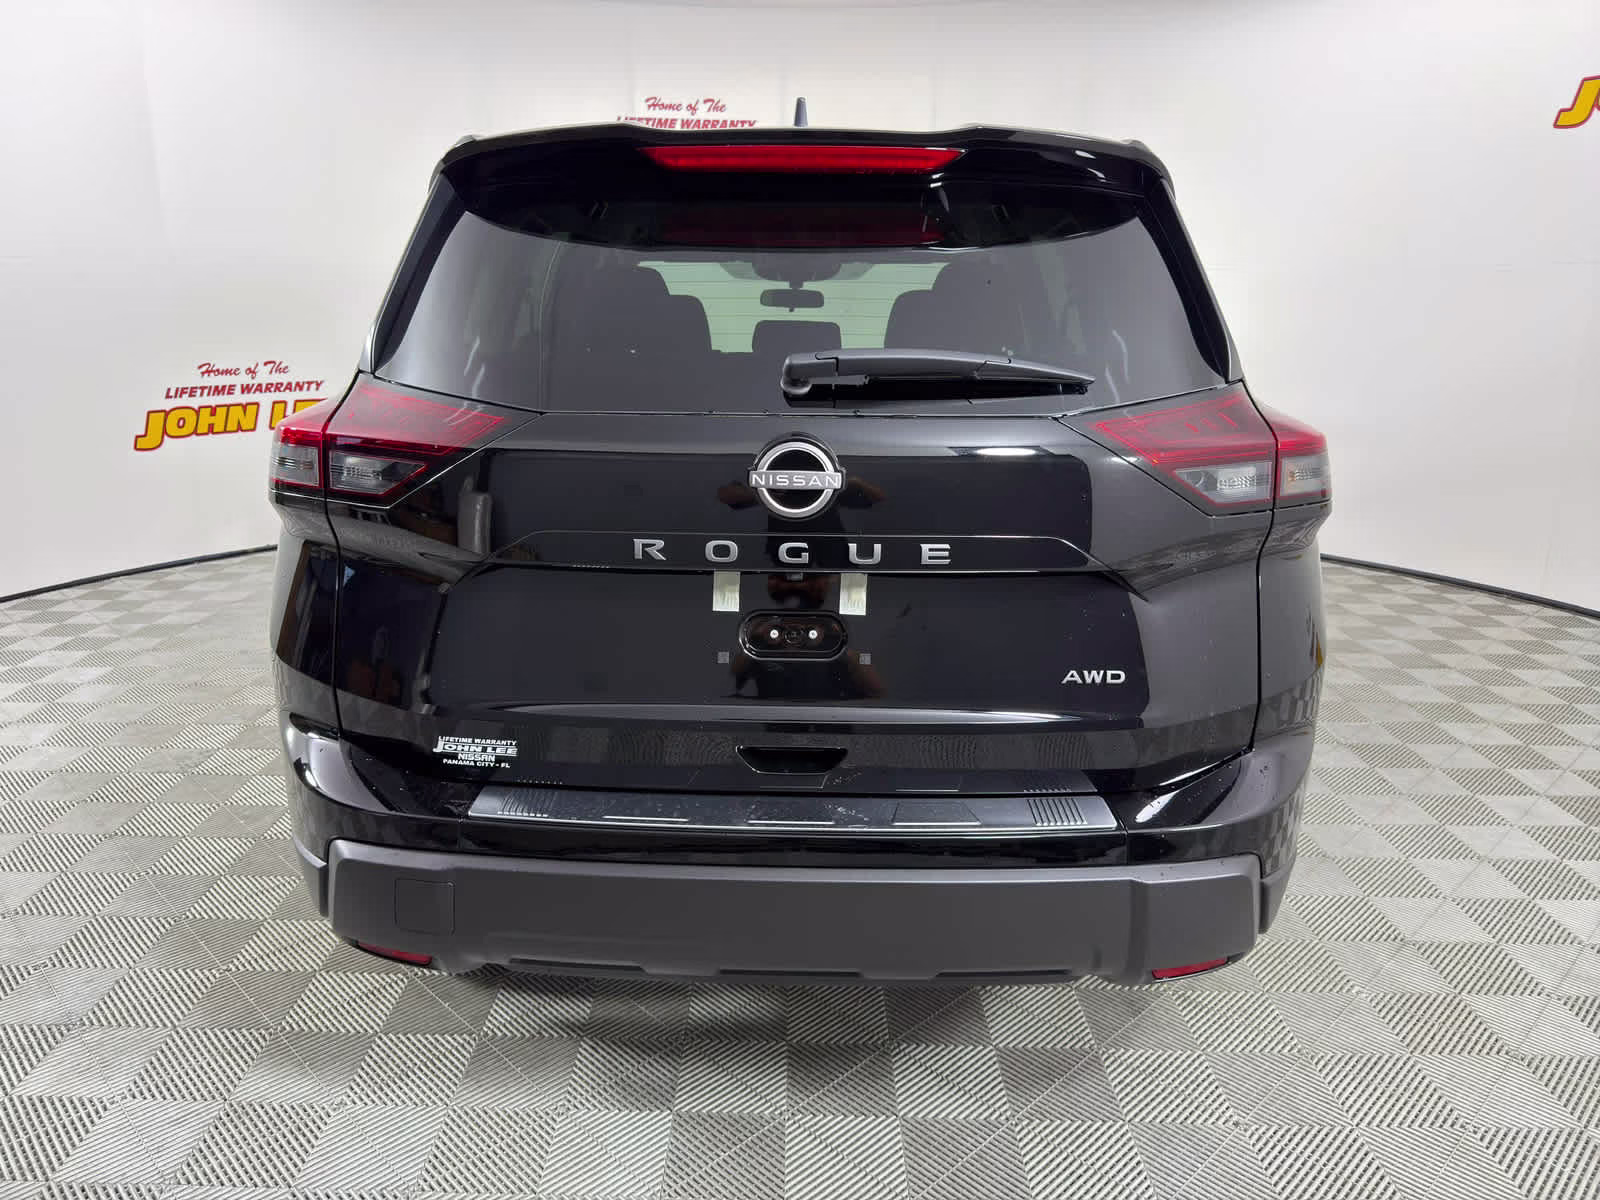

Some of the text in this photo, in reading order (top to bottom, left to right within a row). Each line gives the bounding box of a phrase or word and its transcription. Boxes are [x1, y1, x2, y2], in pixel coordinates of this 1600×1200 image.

[645, 96, 727, 116] Home of The
[617, 116, 677, 129] TIME
[198, 361, 290, 379] Home of The
[165, 380, 324, 399] LIFETIME WARRANTY
[134, 402, 260, 451] JOHN
[752, 472, 841, 488] NISSAN
[633, 538, 952, 566] ROGUE
[1061, 669, 1126, 684] AWD
[438, 735, 472, 743] LIFETIME
[432, 741, 518, 756] JOHN LEE
[443, 758, 474, 766] PANAMA
[458, 753, 495, 761] NISSAN
